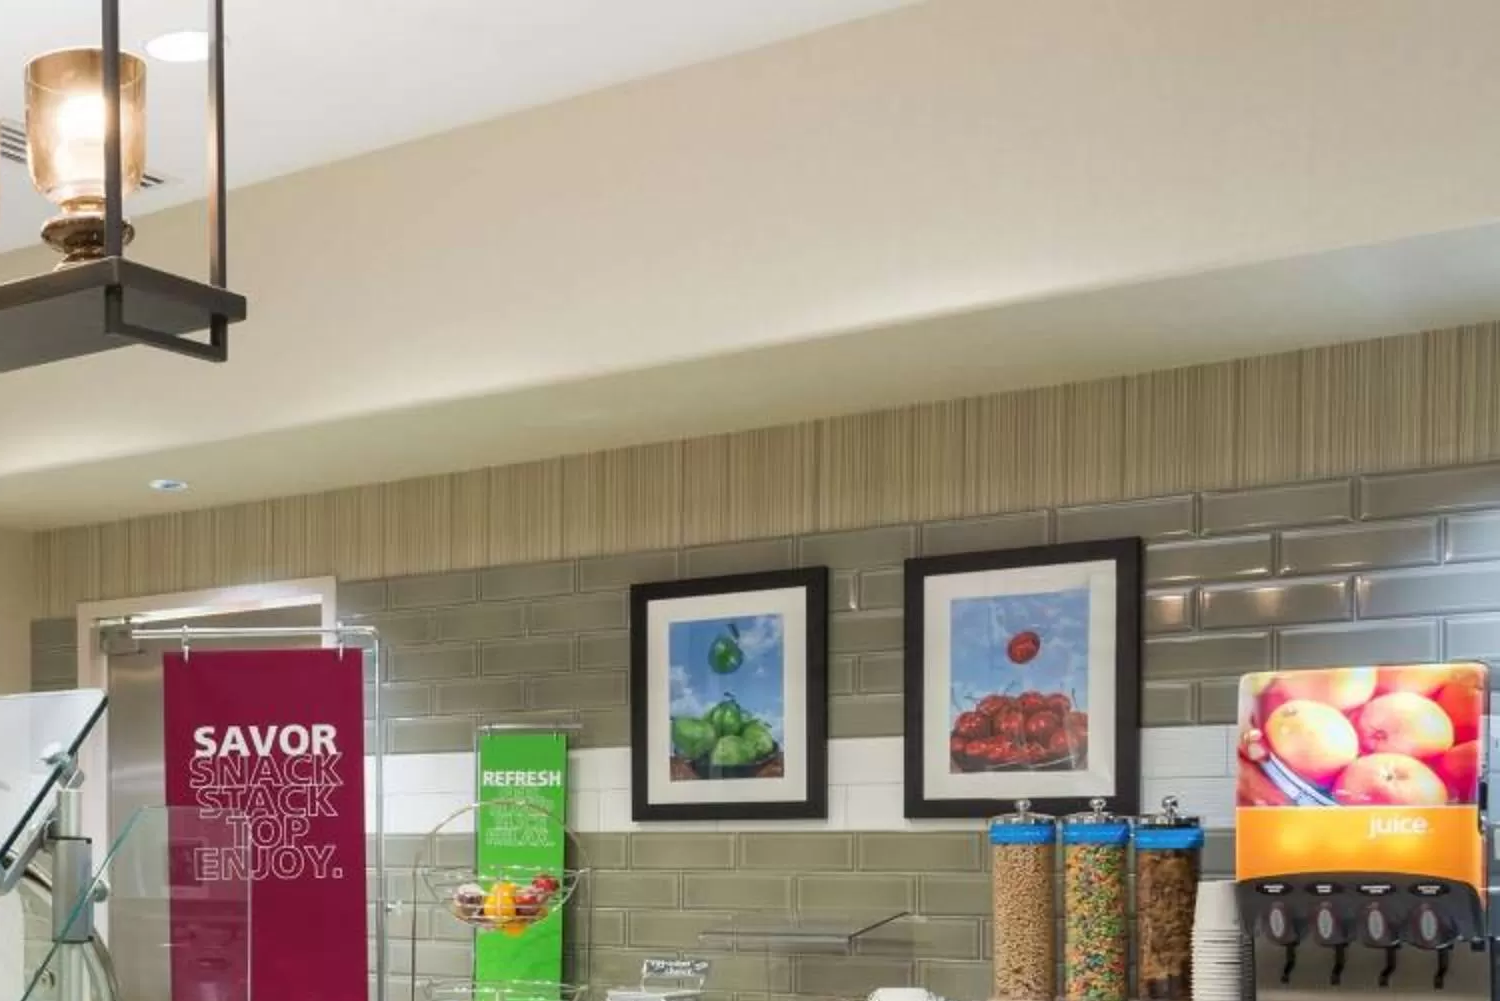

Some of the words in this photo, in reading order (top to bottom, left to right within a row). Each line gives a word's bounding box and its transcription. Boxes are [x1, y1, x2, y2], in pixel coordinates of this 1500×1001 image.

[194, 724, 338, 757] SAVOR
[189, 752, 344, 788] SNACK
[483, 770, 561, 788] REFRESH
[196, 785, 339, 819] STACK
[226, 815, 311, 849] TOP
[1367, 814, 1429, 839] juice
[193, 845, 344, 881] ENJOY.
